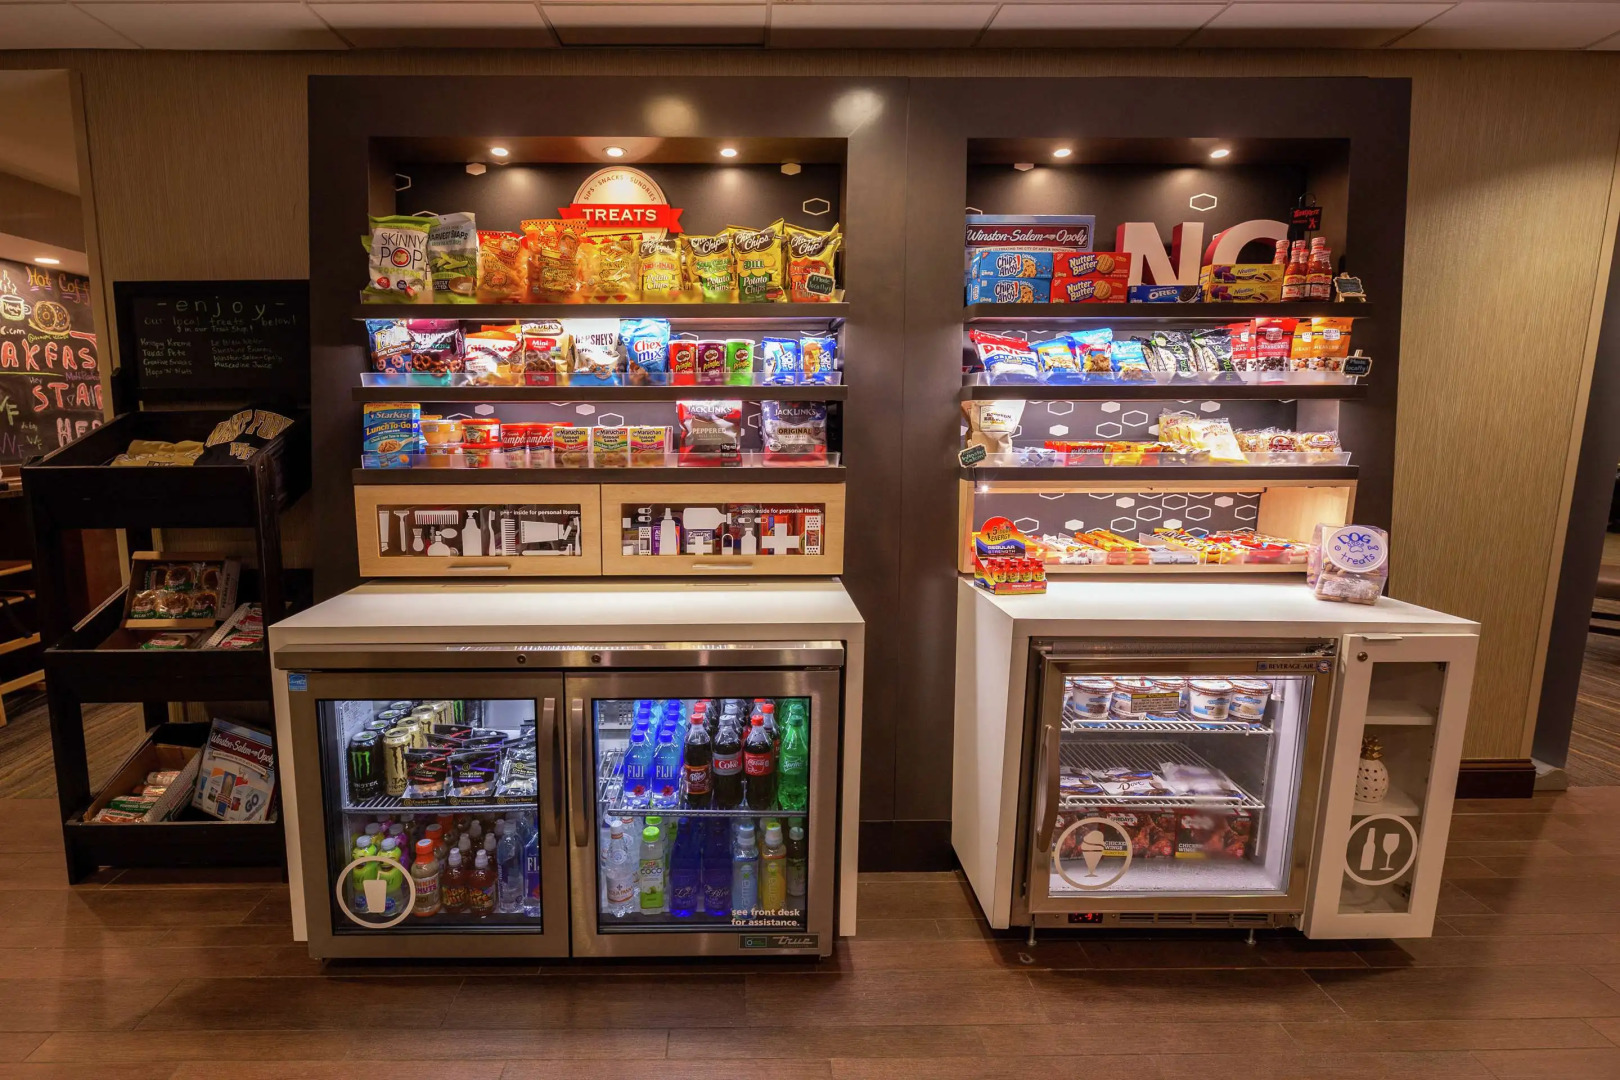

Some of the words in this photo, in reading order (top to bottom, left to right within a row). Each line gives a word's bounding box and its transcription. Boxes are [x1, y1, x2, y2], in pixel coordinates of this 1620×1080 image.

[598, 175, 624, 185] SNACKS
[630, 177, 656, 202] SUNDRIES
[582, 209, 657, 221] TREATS
[745, 235, 769, 250] Chips
[1056, 229, 1088, 244] Opoly
[798, 242, 823, 254] Chips
[744, 260, 764, 270] DILL
[1069, 254, 1095, 267] Nutter
[1072, 260, 1097, 275] Butter
[26, 266, 52, 287] Hot
[743, 275, 767, 286] Potato
[744, 286, 766, 295] Chips
[1067, 280, 1092, 293] Nutter
[1070, 286, 1095, 301] Butter
[1149, 289, 1177, 299] OREO
[175, 296, 266, 320] enjoy
[173, 315, 200, 327] local
[209, 317, 244, 327] treats
[261, 313, 297, 327] below!
[140, 337, 165, 350] Krispy
[167, 337, 192, 348] Kreme
[634, 340, 662, 353] Chex
[142, 349, 164, 357] Texas
[167, 348, 186, 356] Pete
[375, 411, 410, 419] StarKist
[365, 423, 390, 436] Lunch
[990, 533, 1011, 542] ENERGY
[1337, 532, 1372, 545] DOG
[1340, 552, 1376, 565] treats
[718, 760, 739, 769] Coke
[627, 765, 645, 778] FIJI
[656, 765, 673, 778] FIJI
[245, 793, 259, 813] GO
[751, 907, 776, 916] front
[778, 908, 800, 916] desk
[731, 918, 746, 926] for
[748, 918, 800, 926] assistance.
